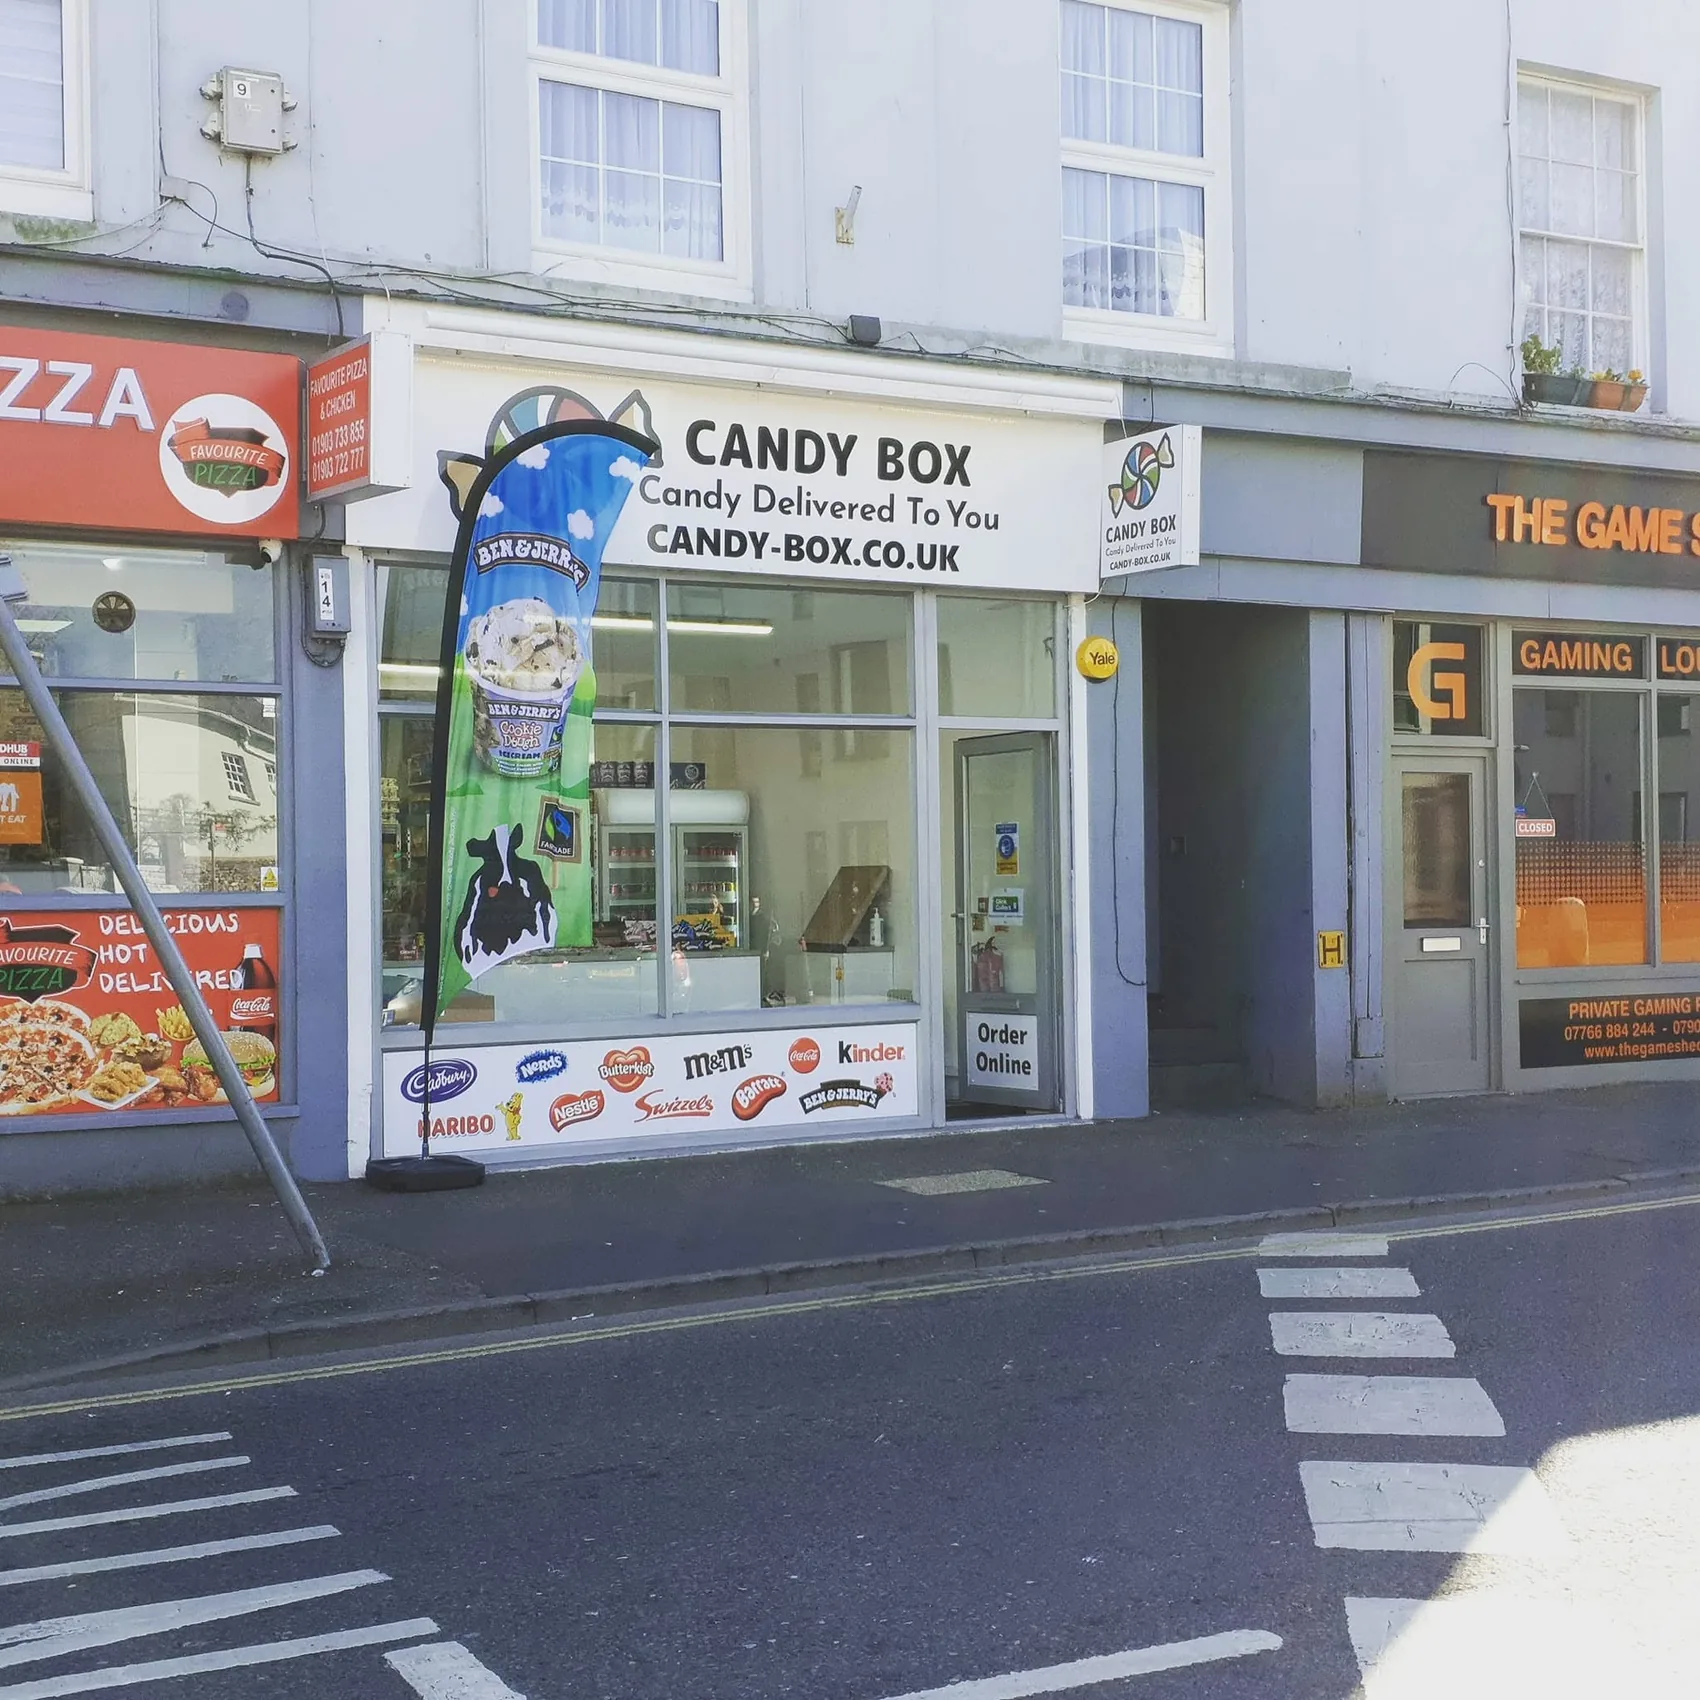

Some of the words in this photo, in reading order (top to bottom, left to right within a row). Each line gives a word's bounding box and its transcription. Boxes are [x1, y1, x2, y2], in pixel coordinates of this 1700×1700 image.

[237, 83, 247, 96] 9
[310, 366, 345, 397] FAVOURITE
[346, 357, 368, 382] PIZZA
[320, 402, 325, 420] &
[326, 390, 356, 418] CHICKEN
[312, 434, 333, 456] 01903
[335, 424, 348, 448] 733
[350, 418, 365, 442] 855
[190, 444, 269, 465] FAVOURITE
[312, 457, 333, 482] 01903
[335, 451, 348, 475] 722
[351, 446, 364, 470] 777
[685, 419, 858, 477] CANDY
[877, 437, 972, 487] BOX
[194, 464, 257, 486] PIZZA
[639, 475, 741, 518] Candy
[753, 484, 895, 522] Delivered
[907, 496, 940, 526] To
[947, 500, 999, 530] You
[1106, 520, 1146, 543] CANDY
[1151, 514, 1176, 534] BOX
[1487, 494, 1568, 545] THE
[1577, 501, 1684, 554] GAME
[647, 524, 959, 572] CANDY-BOX.CO.UK
[478, 539, 585, 585] BEN&JERR'S
[1110, 552, 1171, 570] CANDY-BOX.CO.UK
[1089, 652, 1115, 665] Yale
[1520, 639, 1632, 672] GAMING
[1661, 645, 1700, 674] LO
[1407, 642, 1466, 720] G
[500, 720, 542, 737] Cookie
[504, 733, 541, 751] Dough
[8, 815, 26, 823] EAT
[1518, 823, 1553, 833] CLOSED
[99, 913, 238, 935] DELCIOUS
[100, 943, 147, 964] HOT
[1322, 934, 1341, 965] H
[99, 970, 243, 993] DELIRED
[1569, 1000, 1630, 1020] PRIVATE
[1634, 997, 1691, 1016] GAMING
[978, 1022, 1027, 1045] Order
[1564, 1025, 1602, 1040] 07766
[1606, 1023, 1628, 1038] 884
[1632, 1022, 1655, 1037] 244
[976, 1051, 1031, 1075] Online
[634, 1089, 714, 1123] Swizzels
